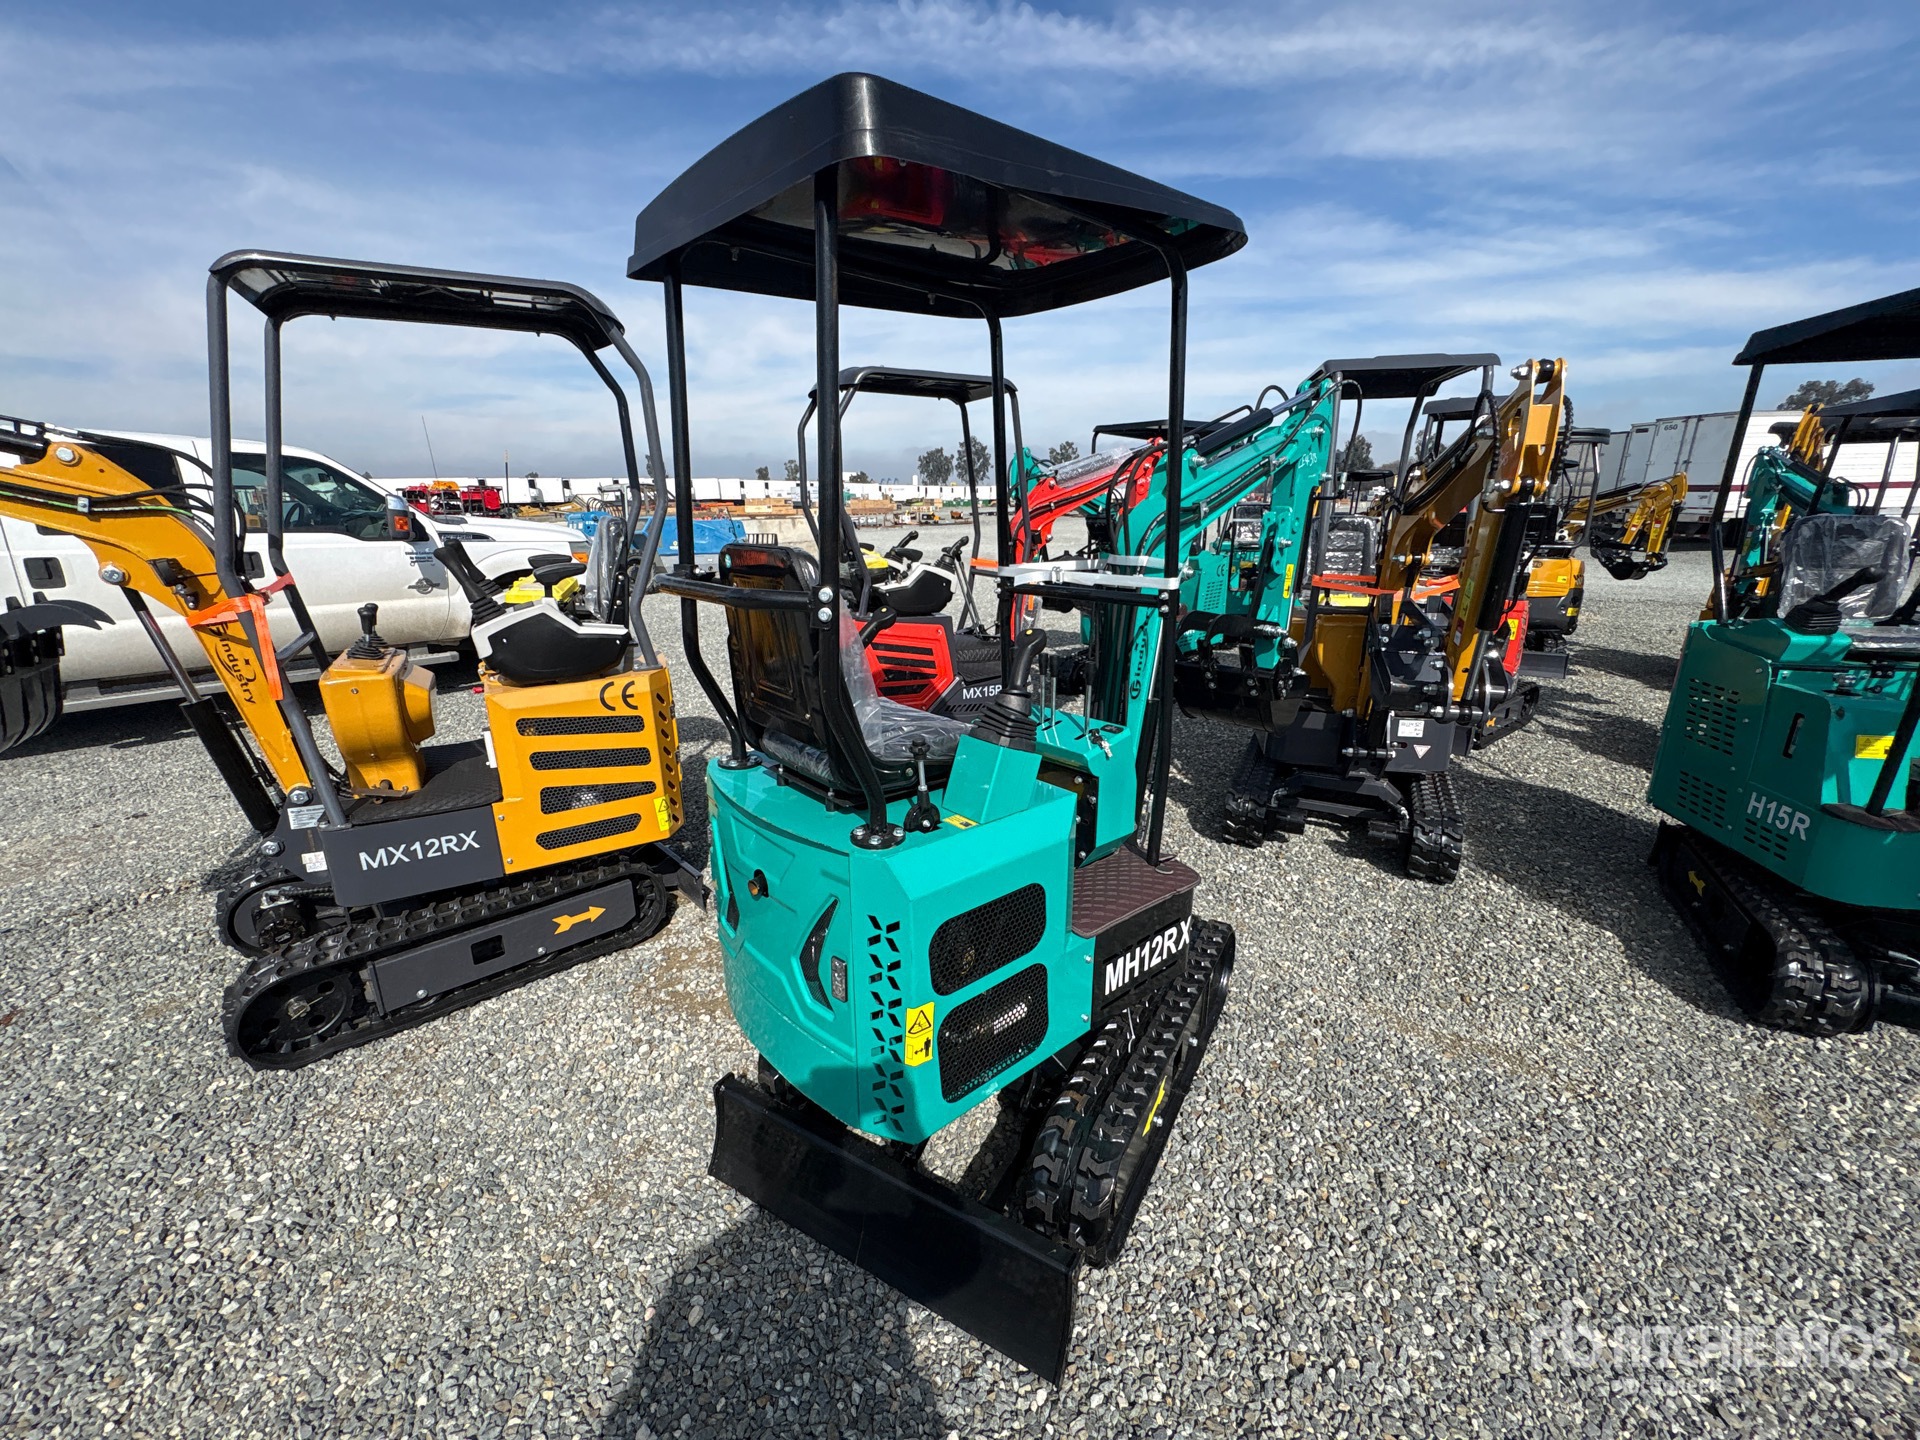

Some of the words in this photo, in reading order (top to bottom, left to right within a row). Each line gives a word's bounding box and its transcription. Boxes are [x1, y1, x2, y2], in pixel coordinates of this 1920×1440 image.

[599, 680, 638, 711] CE
[1747, 791, 1811, 841] H15R
[358, 830, 481, 871] MX12RX
[1104, 915, 1192, 996] MH12RX
